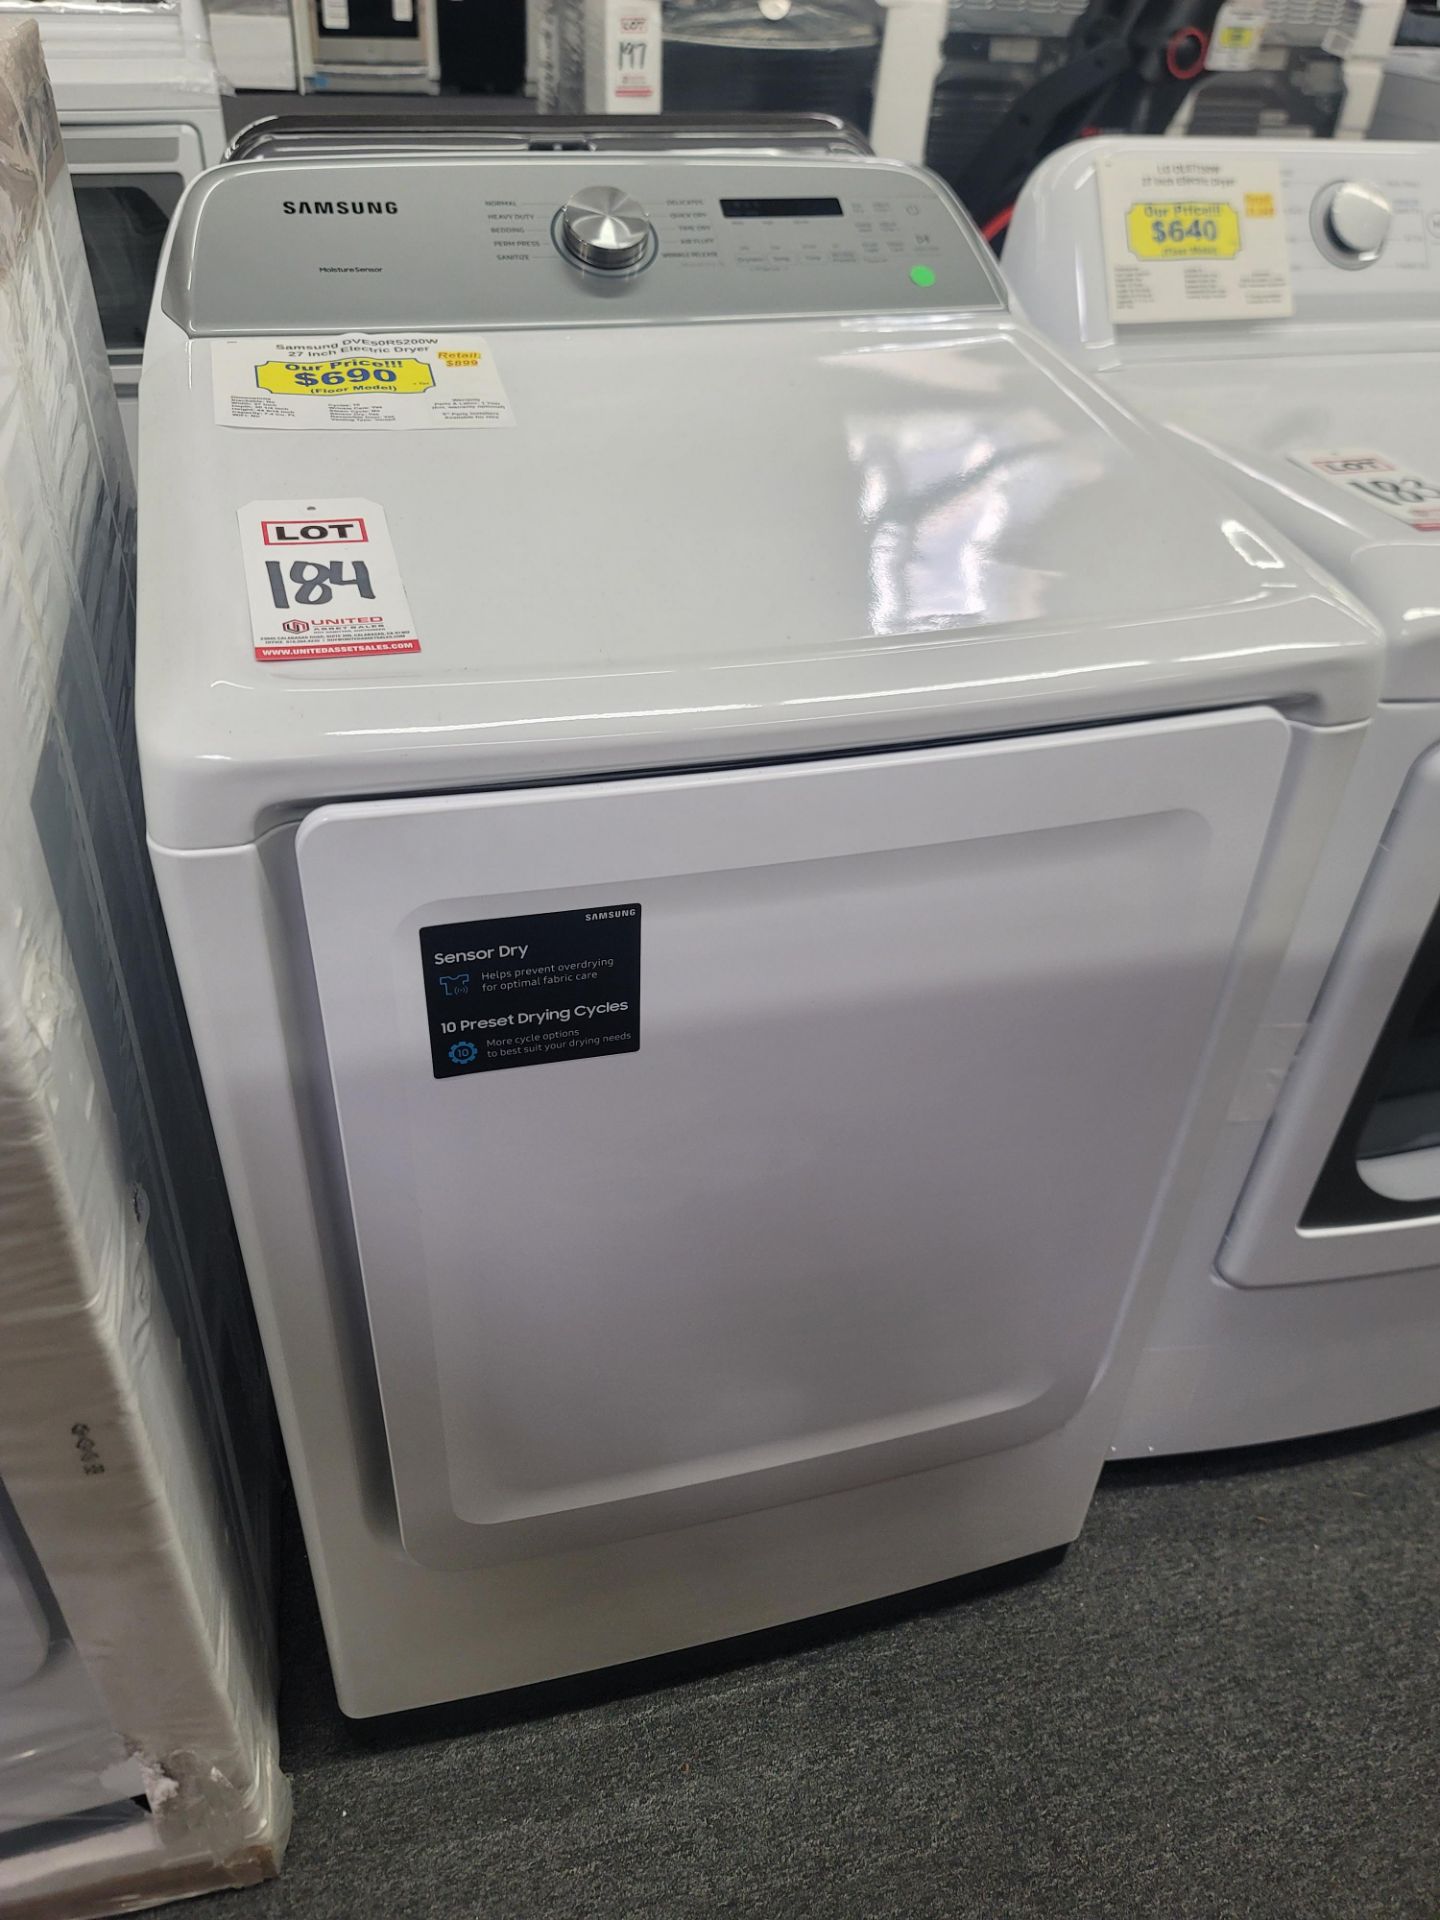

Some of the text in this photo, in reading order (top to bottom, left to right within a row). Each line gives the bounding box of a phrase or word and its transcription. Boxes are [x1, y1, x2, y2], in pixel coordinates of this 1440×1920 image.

[283, 201, 398, 214] SAMSUNG
[1152, 220, 1217, 244] $640
[276, 338, 438, 351] Samsung DVE50R5200W
[330, 360, 404, 370] Price!!!
[294, 368, 398, 387] $690
[276, 524, 354, 541] LOT
[265, 560, 376, 609] 184
[311, 616, 384, 626] UNITED
[262, 642, 414, 656] WWW.UNITEDASSETSALES.COM
[585, 908, 636, 922] SAMSUNG
[434, 944, 529, 965] Sensor Dry
[482, 958, 614, 982] Helps prevent overdrying
[482, 972, 598, 992] for optimal fabric care
[440, 1001, 629, 1034] 10 Preset Drying Cycles
[486, 1028, 580, 1048] More cycle options
[487, 1032, 632, 1058] to best suit your drying needs
[457, 1049, 470, 1058] 10
